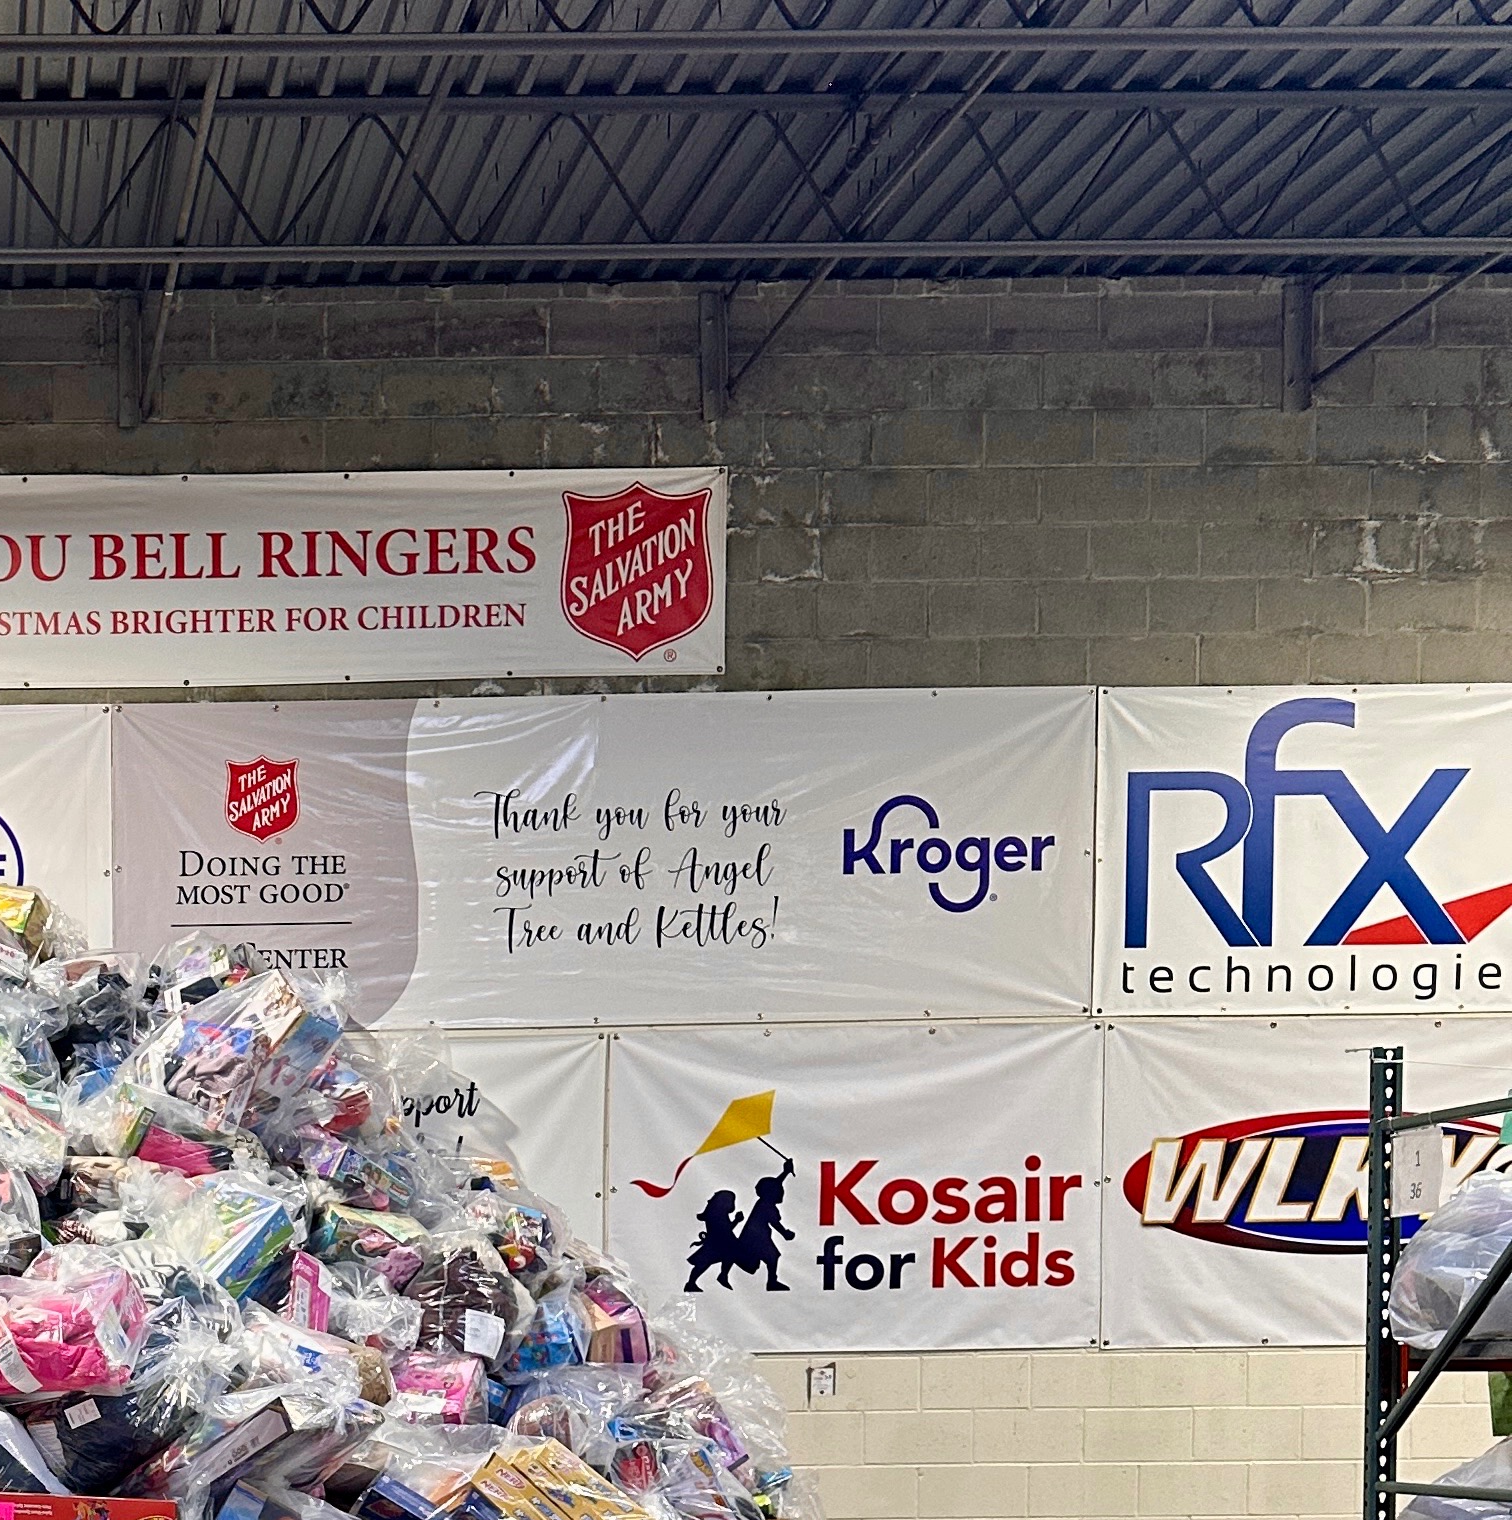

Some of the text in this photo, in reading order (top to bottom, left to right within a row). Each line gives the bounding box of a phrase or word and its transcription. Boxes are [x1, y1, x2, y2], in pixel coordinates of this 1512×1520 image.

[89, 531, 241, 581] BELL
[257, 526, 536, 579] RINGERS
[589, 501, 647, 558] THE
[569, 509, 696, 616] SALVATION
[110, 609, 275, 635] BRIGHTER
[285, 606, 348, 633] FOR
[357, 603, 527, 631] CHILDREN
[617, 559, 693, 639] ARMY
[229, 769, 291, 822] SALVATION
[239, 766, 267, 792] THE
[252, 794, 290, 831] ARMY
[474, 788, 787, 842] Thank you for your
[496, 842, 774, 899] support of Angel
[843, 795, 1055, 913] Kroger
[176, 883, 344, 905] MOST GOOD
[493, 896, 780, 949] Tree and Kettles!
[1122, 954, 1503, 999] technologie
[819, 1154, 1082, 1225] Kosair
[1409, 1183, 1422, 1200] 36
[817, 1232, 1075, 1291] for Kids
[479, 1480, 509, 1500] NERF
[495, 1467, 525, 1489] NERF
